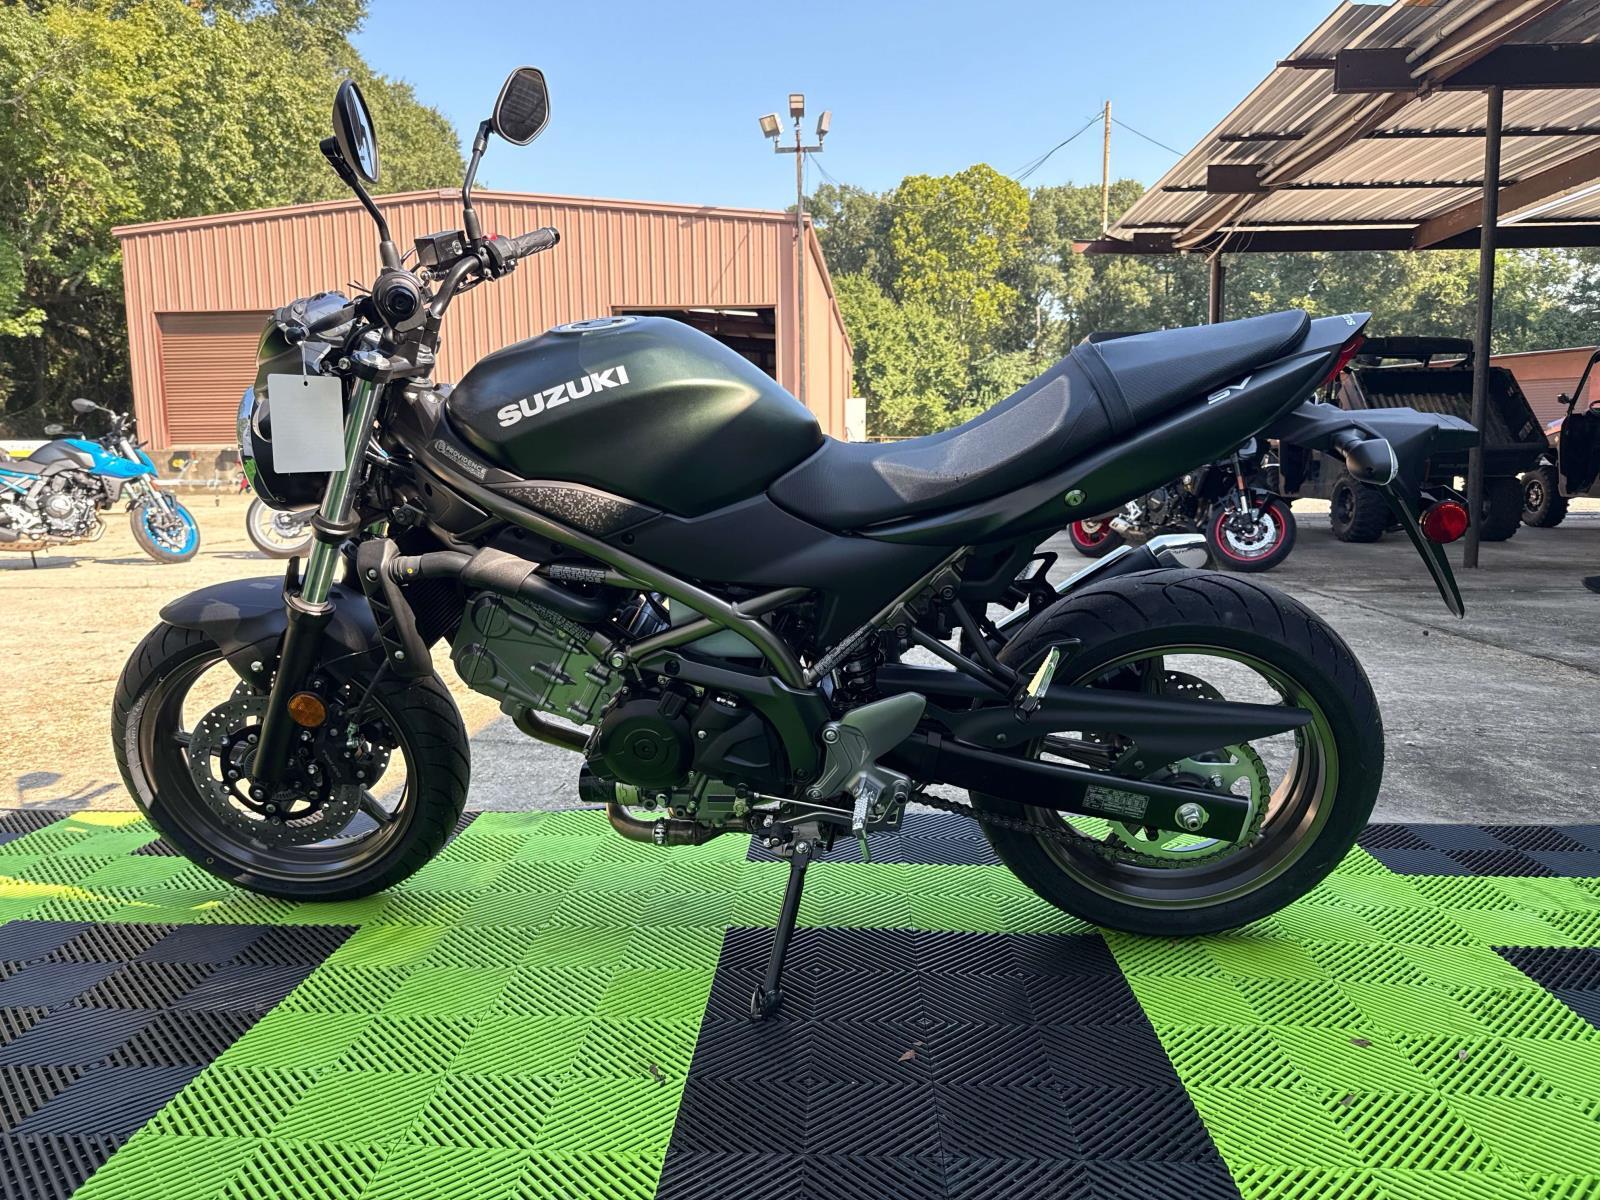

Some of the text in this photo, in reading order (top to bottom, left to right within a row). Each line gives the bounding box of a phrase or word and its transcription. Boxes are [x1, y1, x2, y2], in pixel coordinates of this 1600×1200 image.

[497, 365, 629, 427] SUZUKI
[1208, 375, 1252, 405] SV
[446, 446, 487, 474] PROVIDENCE
